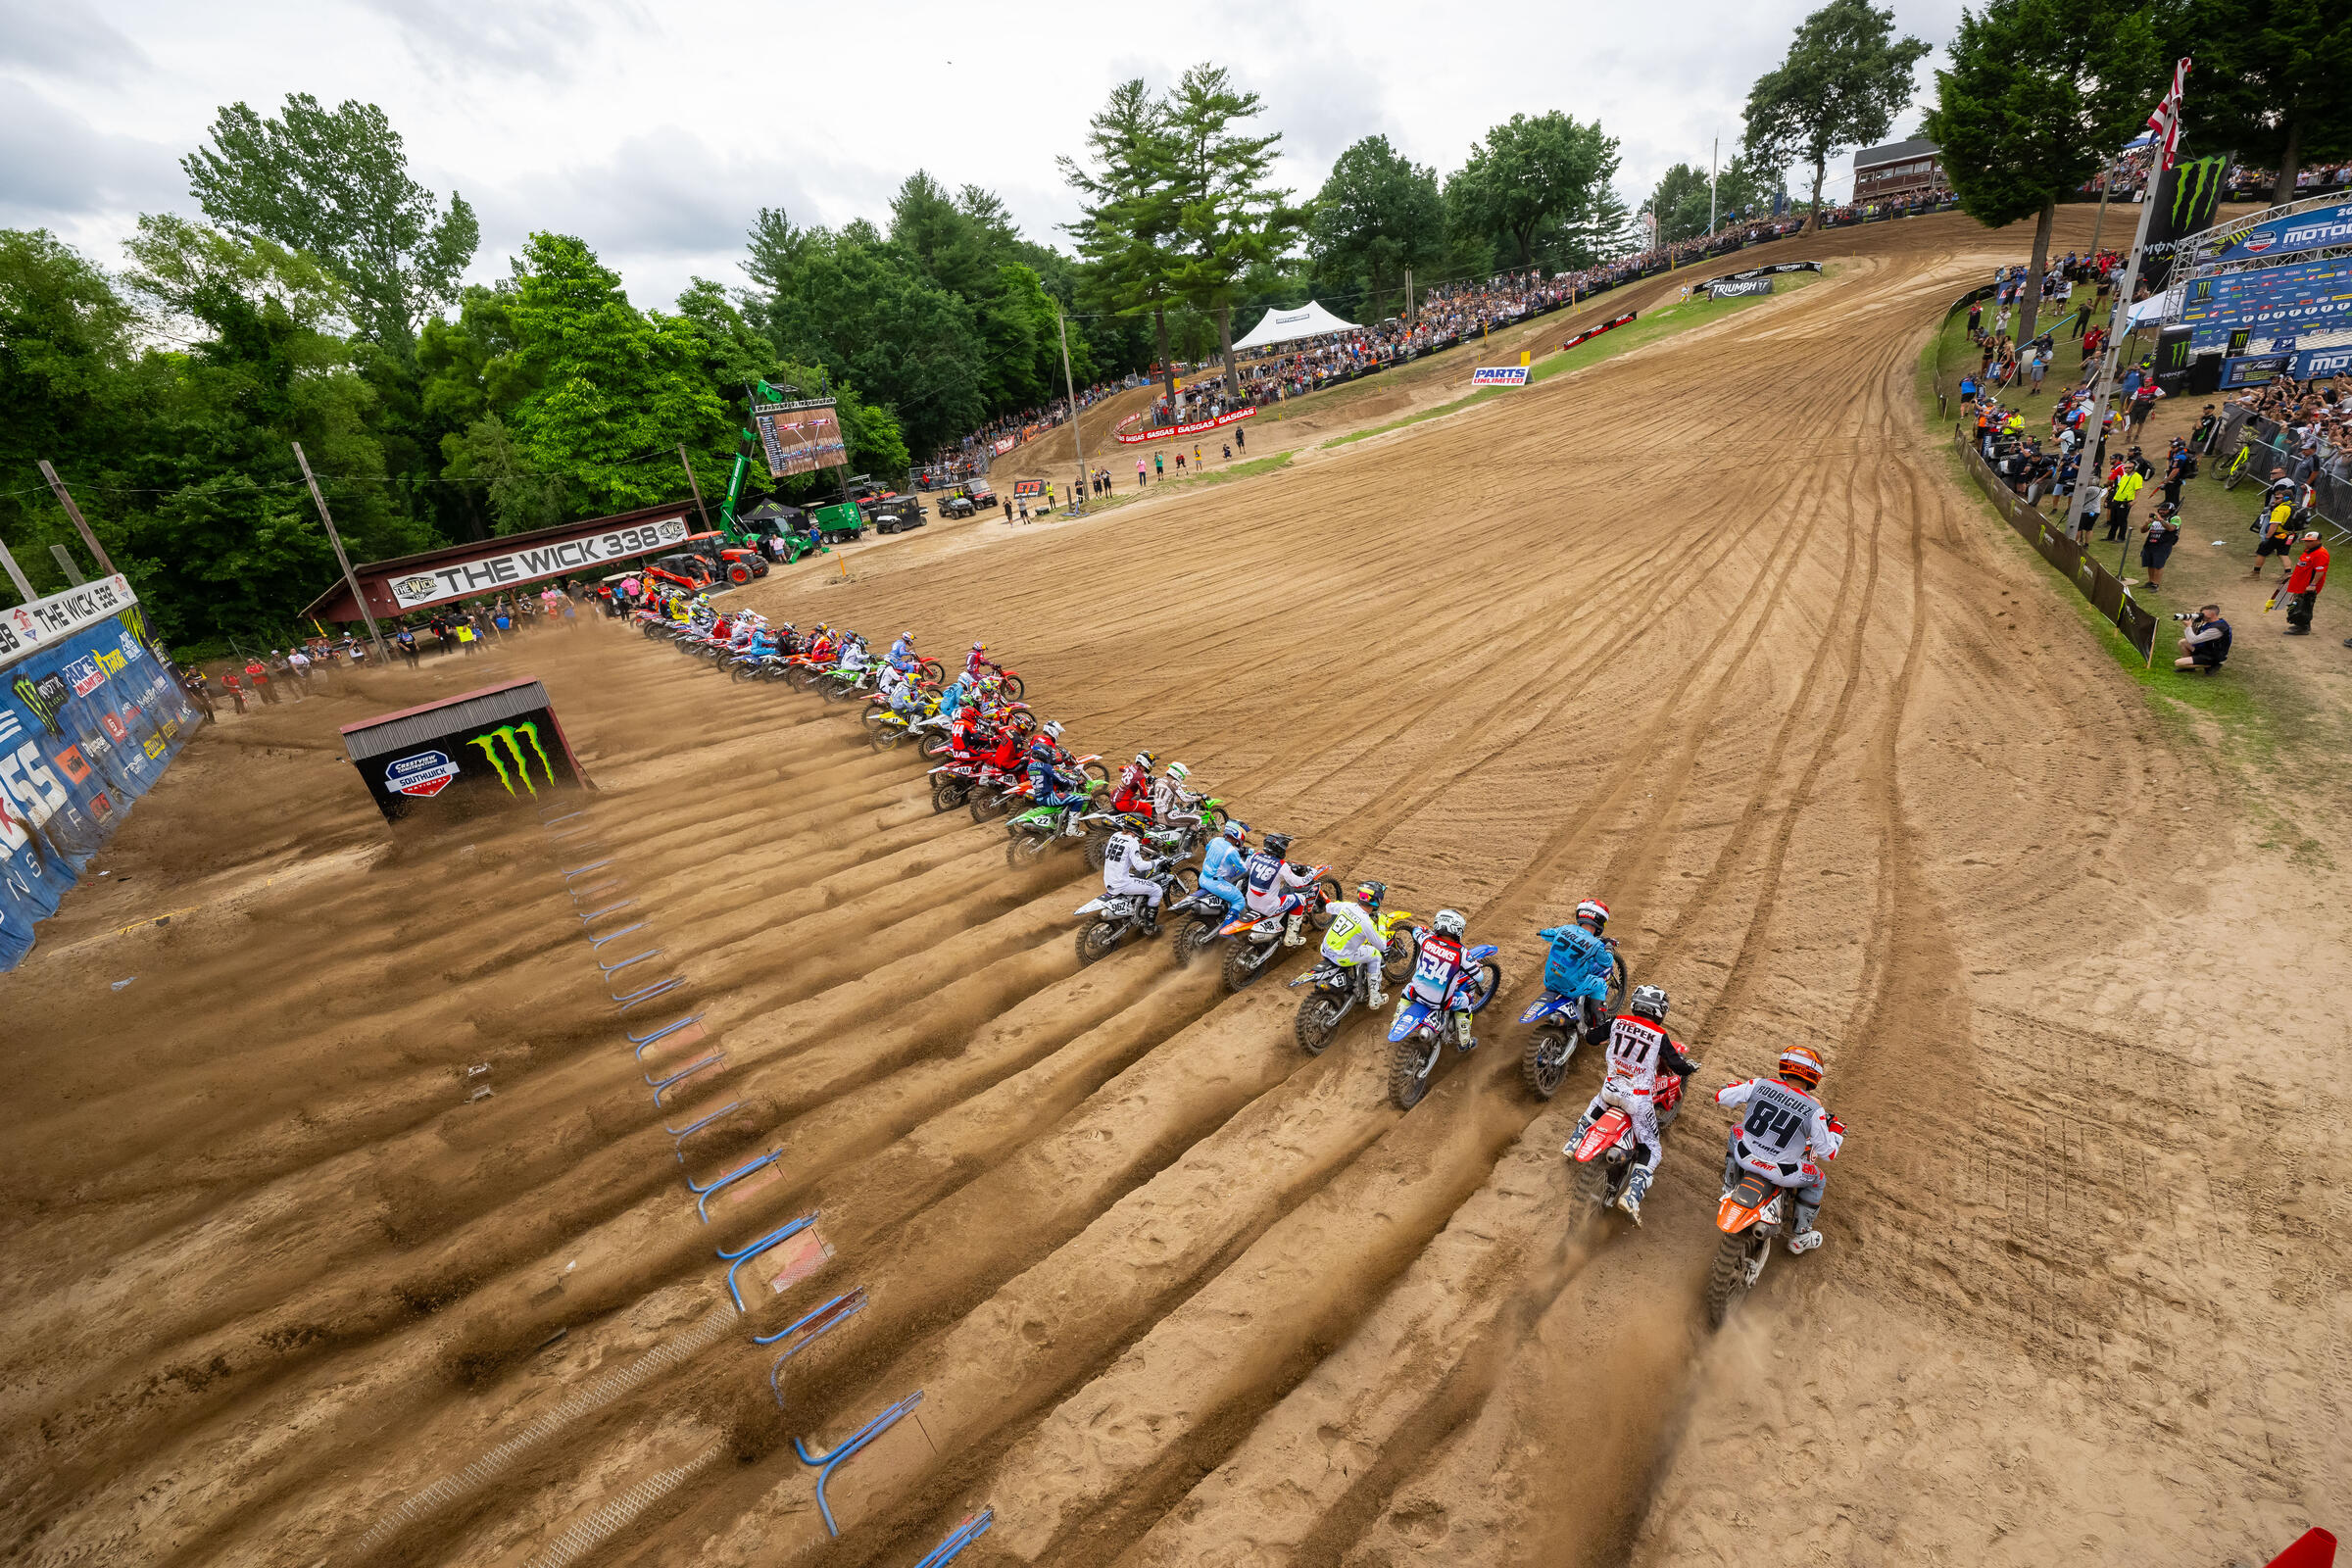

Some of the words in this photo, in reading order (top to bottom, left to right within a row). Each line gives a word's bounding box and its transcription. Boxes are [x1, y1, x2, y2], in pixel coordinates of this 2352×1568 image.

[1713, 281, 1757, 296] TRIUMPH
[1475, 368, 1526, 378] PARTS
[1218, 408, 1255, 424] GASGAS
[1147, 427, 1175, 439] GASGAS
[1177, 419, 1215, 433] GASGAS
[1016, 480, 1042, 494] ETS
[435, 557, 519, 593] THE
[519, 540, 603, 573] WICK
[602, 525, 661, 558] 338
[392, 585, 412, 596] THE
[408, 578, 438, 594] WICK
[32, 603, 71, 633] THE
[62, 591, 101, 621] WICK
[94, 585, 119, 610] 338
[395, 754, 436, 770] CRESTVIEW
[399, 766, 447, 787] SOUTHWICK
[407, 776, 447, 792] NATIONAL
[1111, 835, 1129, 844] TAIT
[1252, 861, 1277, 882] 148
[1111, 901, 1126, 911] 962
[1260, 920, 1275, 932] 148
[1332, 913, 1355, 937] 87
[1424, 941, 1457, 961] BROOKS
[1418, 952, 1452, 986] 534
[1615, 1021, 1656, 1044] STEPEK
[1613, 1032, 1651, 1064] 177
[1755, 1085, 1813, 1117] RODRIGUEZ
[1743, 1099, 1805, 1150] 84
